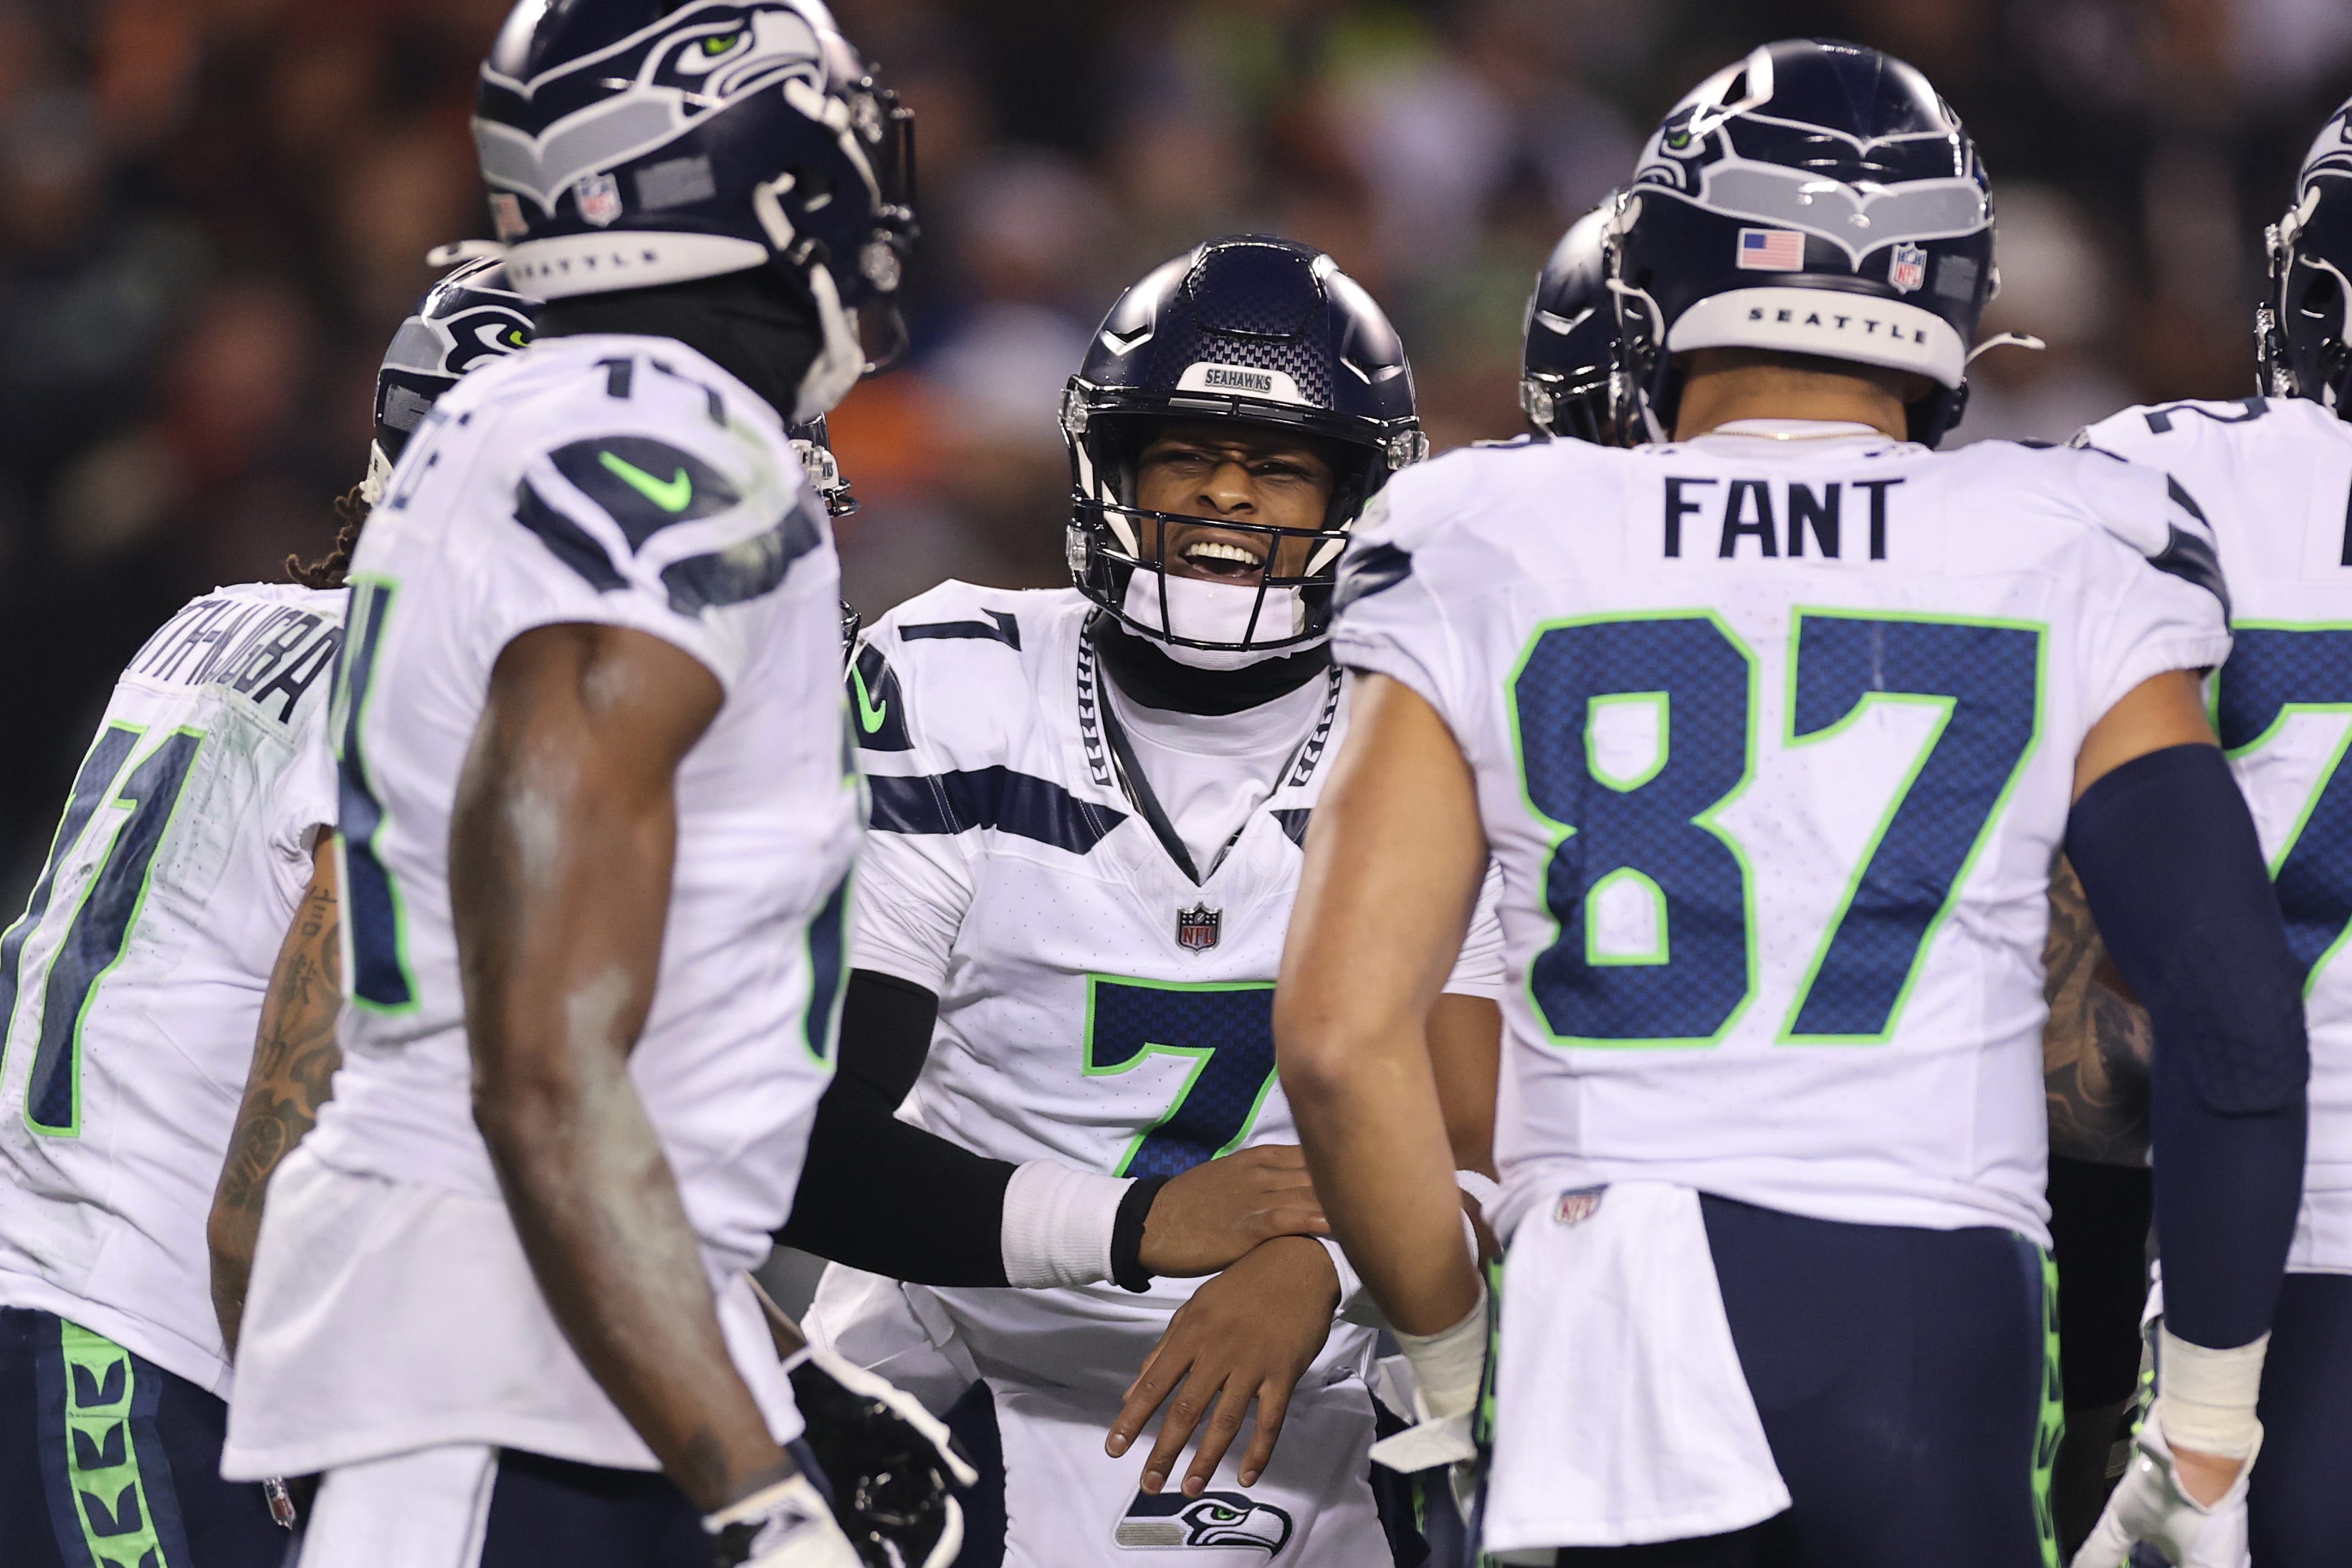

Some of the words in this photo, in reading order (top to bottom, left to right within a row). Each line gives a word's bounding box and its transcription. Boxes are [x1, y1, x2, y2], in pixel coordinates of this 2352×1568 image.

[1749, 307, 1927, 345] SEATTLE
[1205, 368, 1273, 392] SEAHAWKS
[1664, 476, 1906, 561] FANT
[1504, 605, 2050, 1047] 87
[0, 719, 206, 1137] 11
[1182, 927, 1214, 946] NFL
[1083, 972, 1278, 1180] 7
